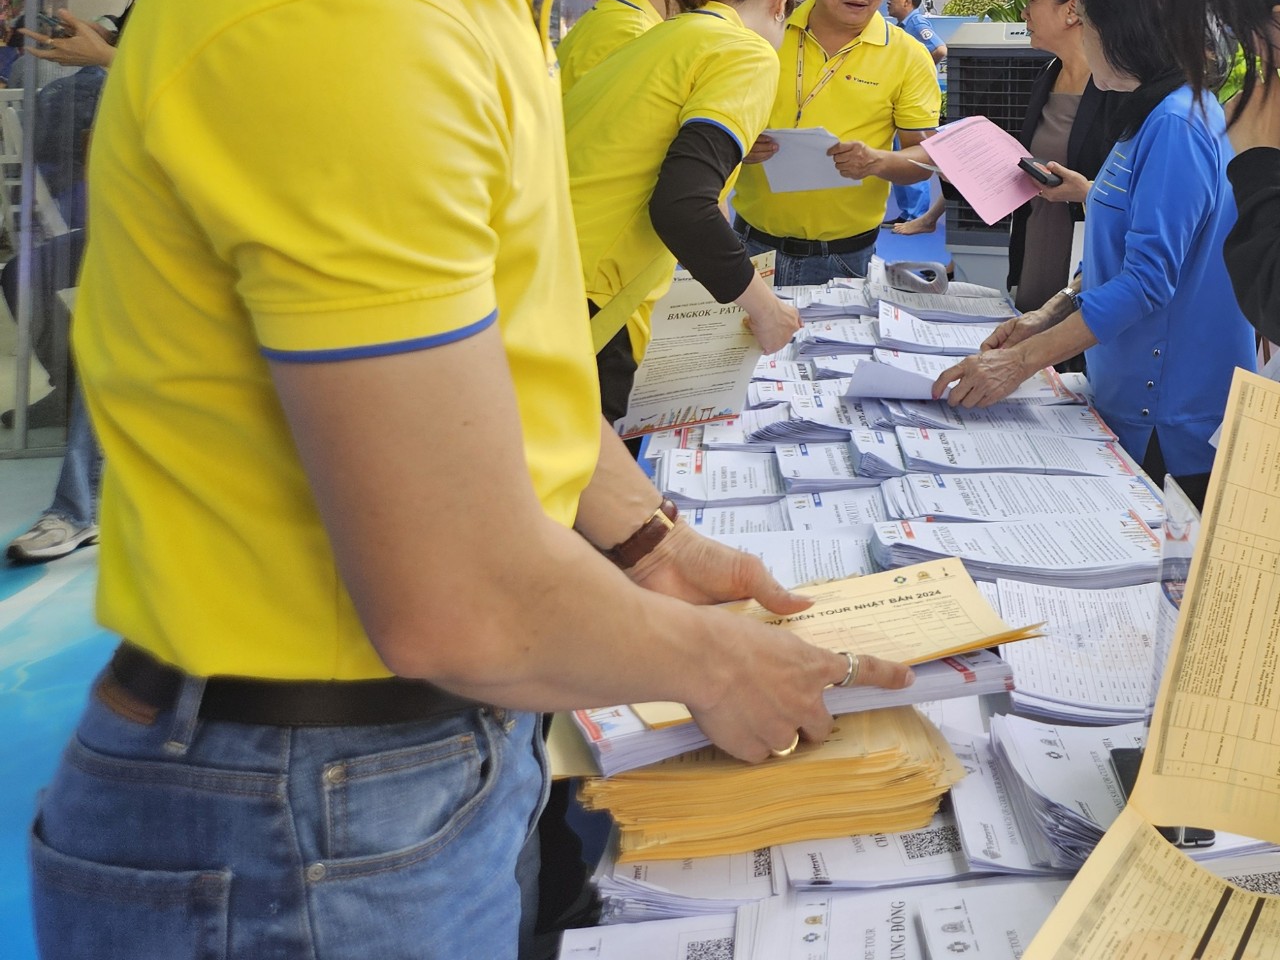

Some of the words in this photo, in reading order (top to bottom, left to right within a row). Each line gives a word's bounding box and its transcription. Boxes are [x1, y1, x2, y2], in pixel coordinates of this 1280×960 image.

[667, 309, 711, 321] BANGKOK
[819, 606, 851, 617] TOUR
[854, 599, 885, 611] NHẬT
[916, 589, 942, 599] 2024
[884, 900, 906, 937] ĐÔNG
